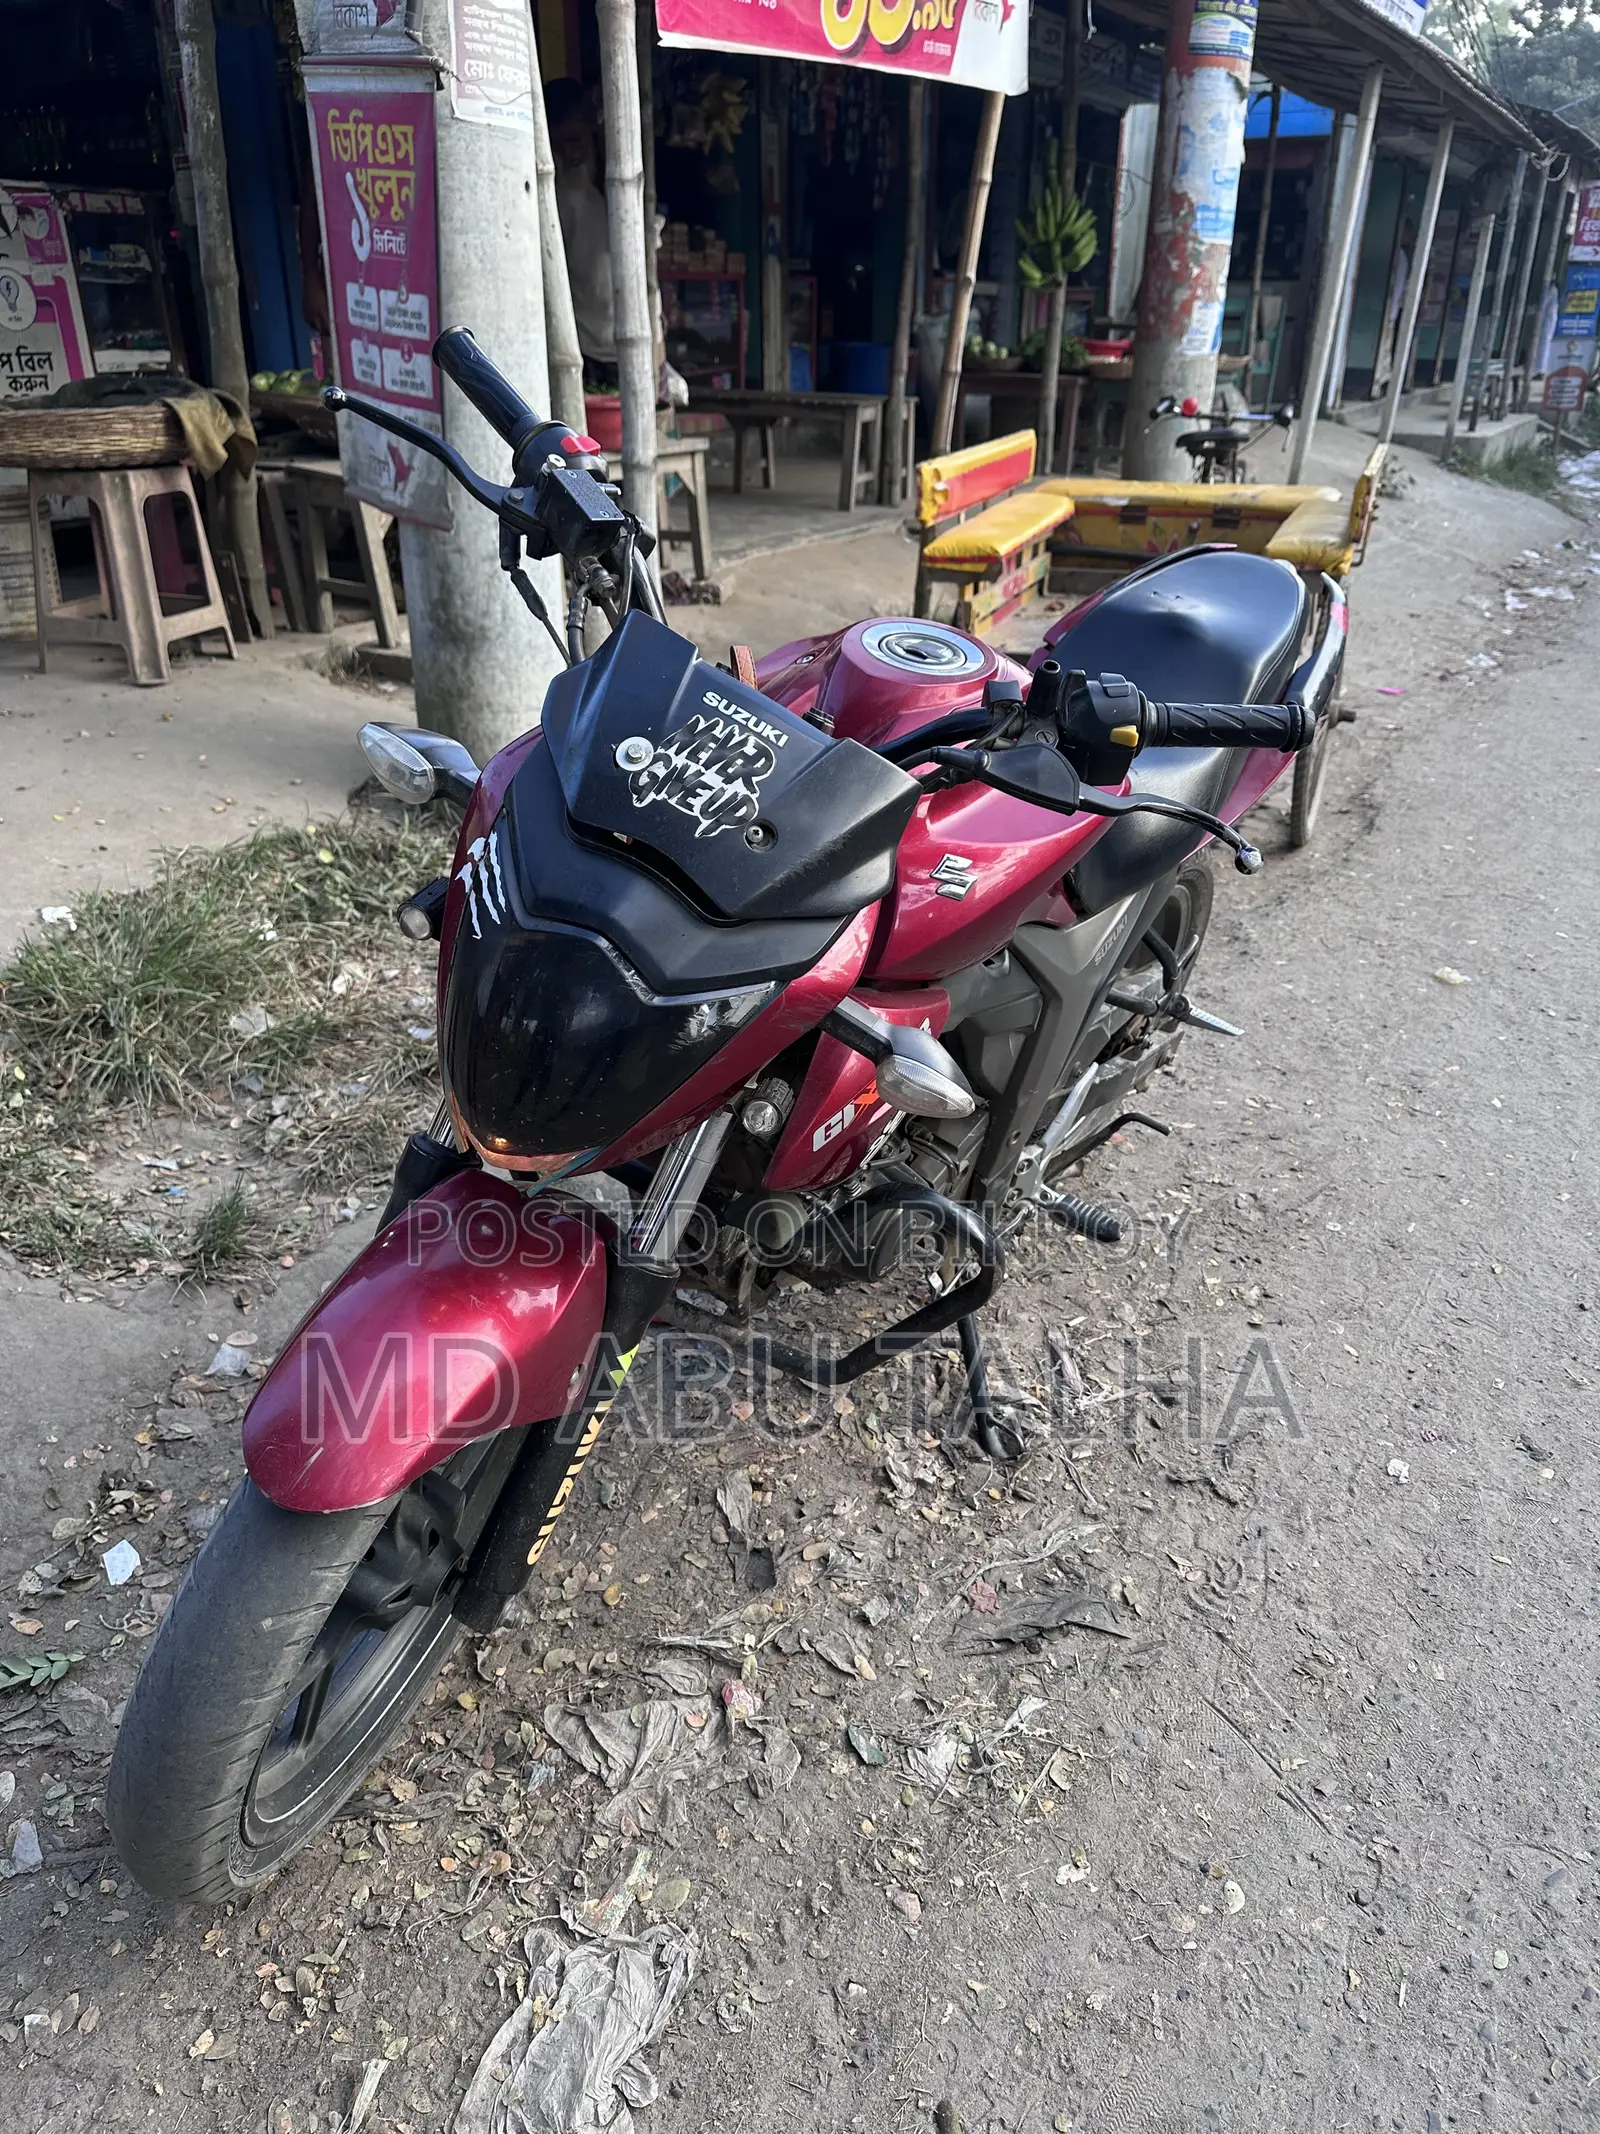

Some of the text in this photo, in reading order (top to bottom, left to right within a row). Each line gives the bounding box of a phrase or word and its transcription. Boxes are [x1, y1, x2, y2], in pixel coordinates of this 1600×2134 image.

[464, 59, 494, 80] মোঃ
[327, 108, 414, 166] ডিপিএস
[355, 167, 416, 221] খুলুন
[373, 228, 407, 255] মিনিটে
[6, 375, 50, 393] করুন
[15, 345, 53, 373] বিল
[702, 691, 789, 748] SUZUKI
[657, 715, 776, 799] NEVER
[694, 787, 759, 838] UP
[1094, 914, 1128, 966] SUZUKI
